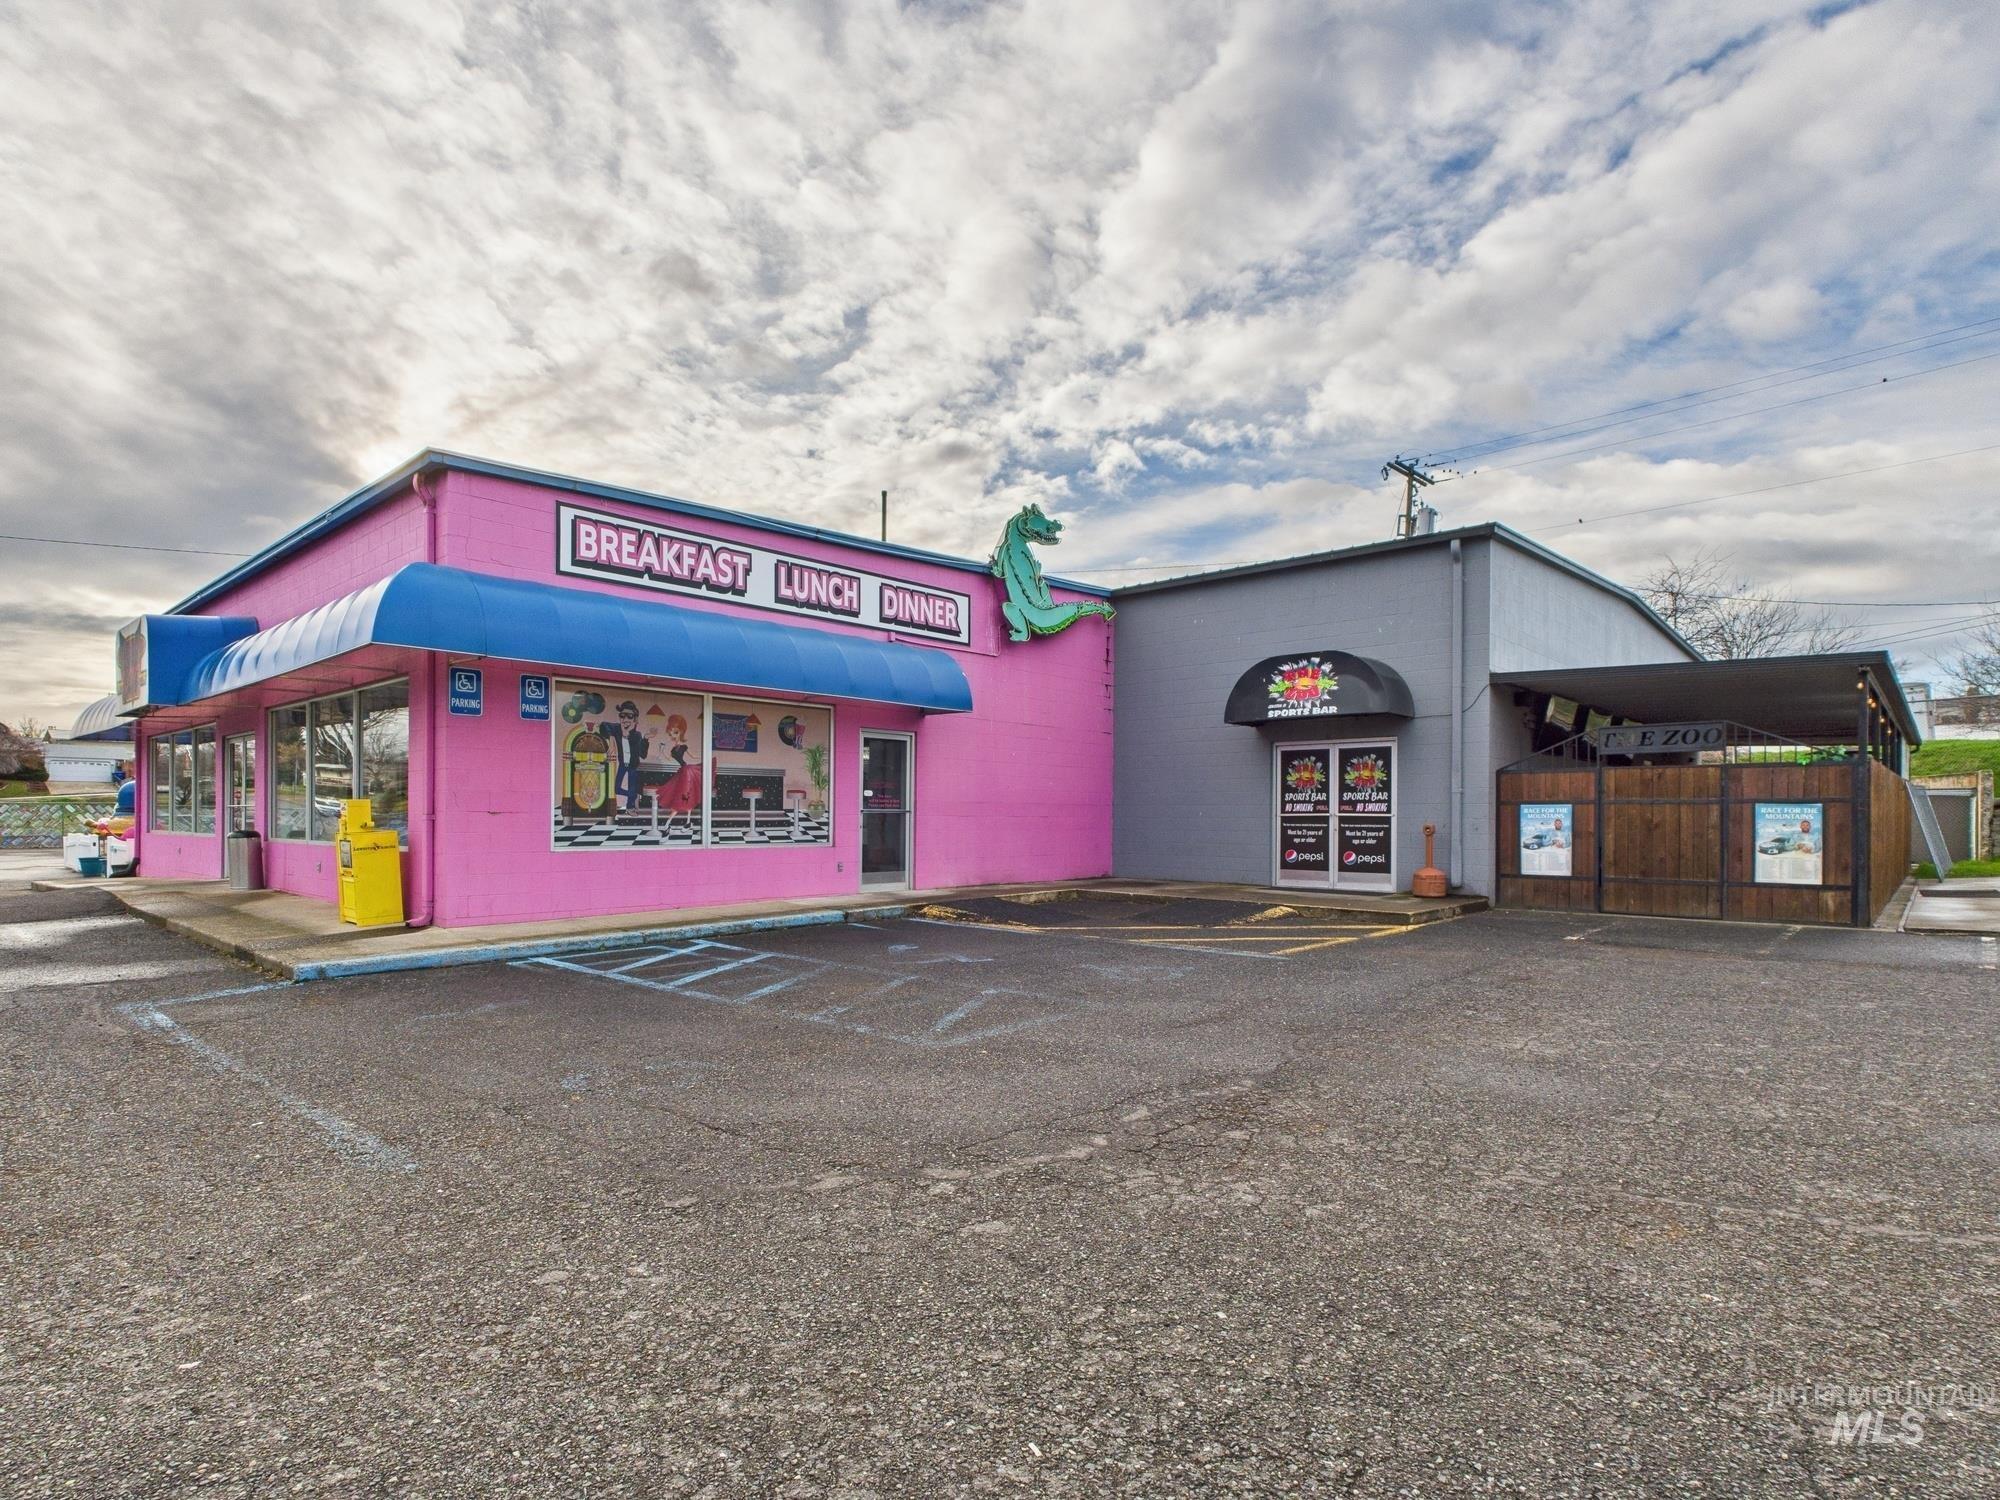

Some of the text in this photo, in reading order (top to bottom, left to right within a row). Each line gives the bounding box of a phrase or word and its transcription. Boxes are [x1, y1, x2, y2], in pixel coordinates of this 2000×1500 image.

[573, 516, 961, 633] BREAKFAST LUNCH DINNER
[451, 697, 481, 709] PARKING
[521, 703, 549, 714] PARKING
[1267, 706, 1338, 718] SPORTS BAR
[1661, 728, 1722, 746] ZOO
[1284, 792, 1327, 802] SPORTS BAR
[1342, 791, 1389, 802] SPORTS BAR
[1364, 803, 1388, 812] SMOKING
[1298, 852, 1324, 862] pepsi
[1357, 854, 1386, 864] pepsi
